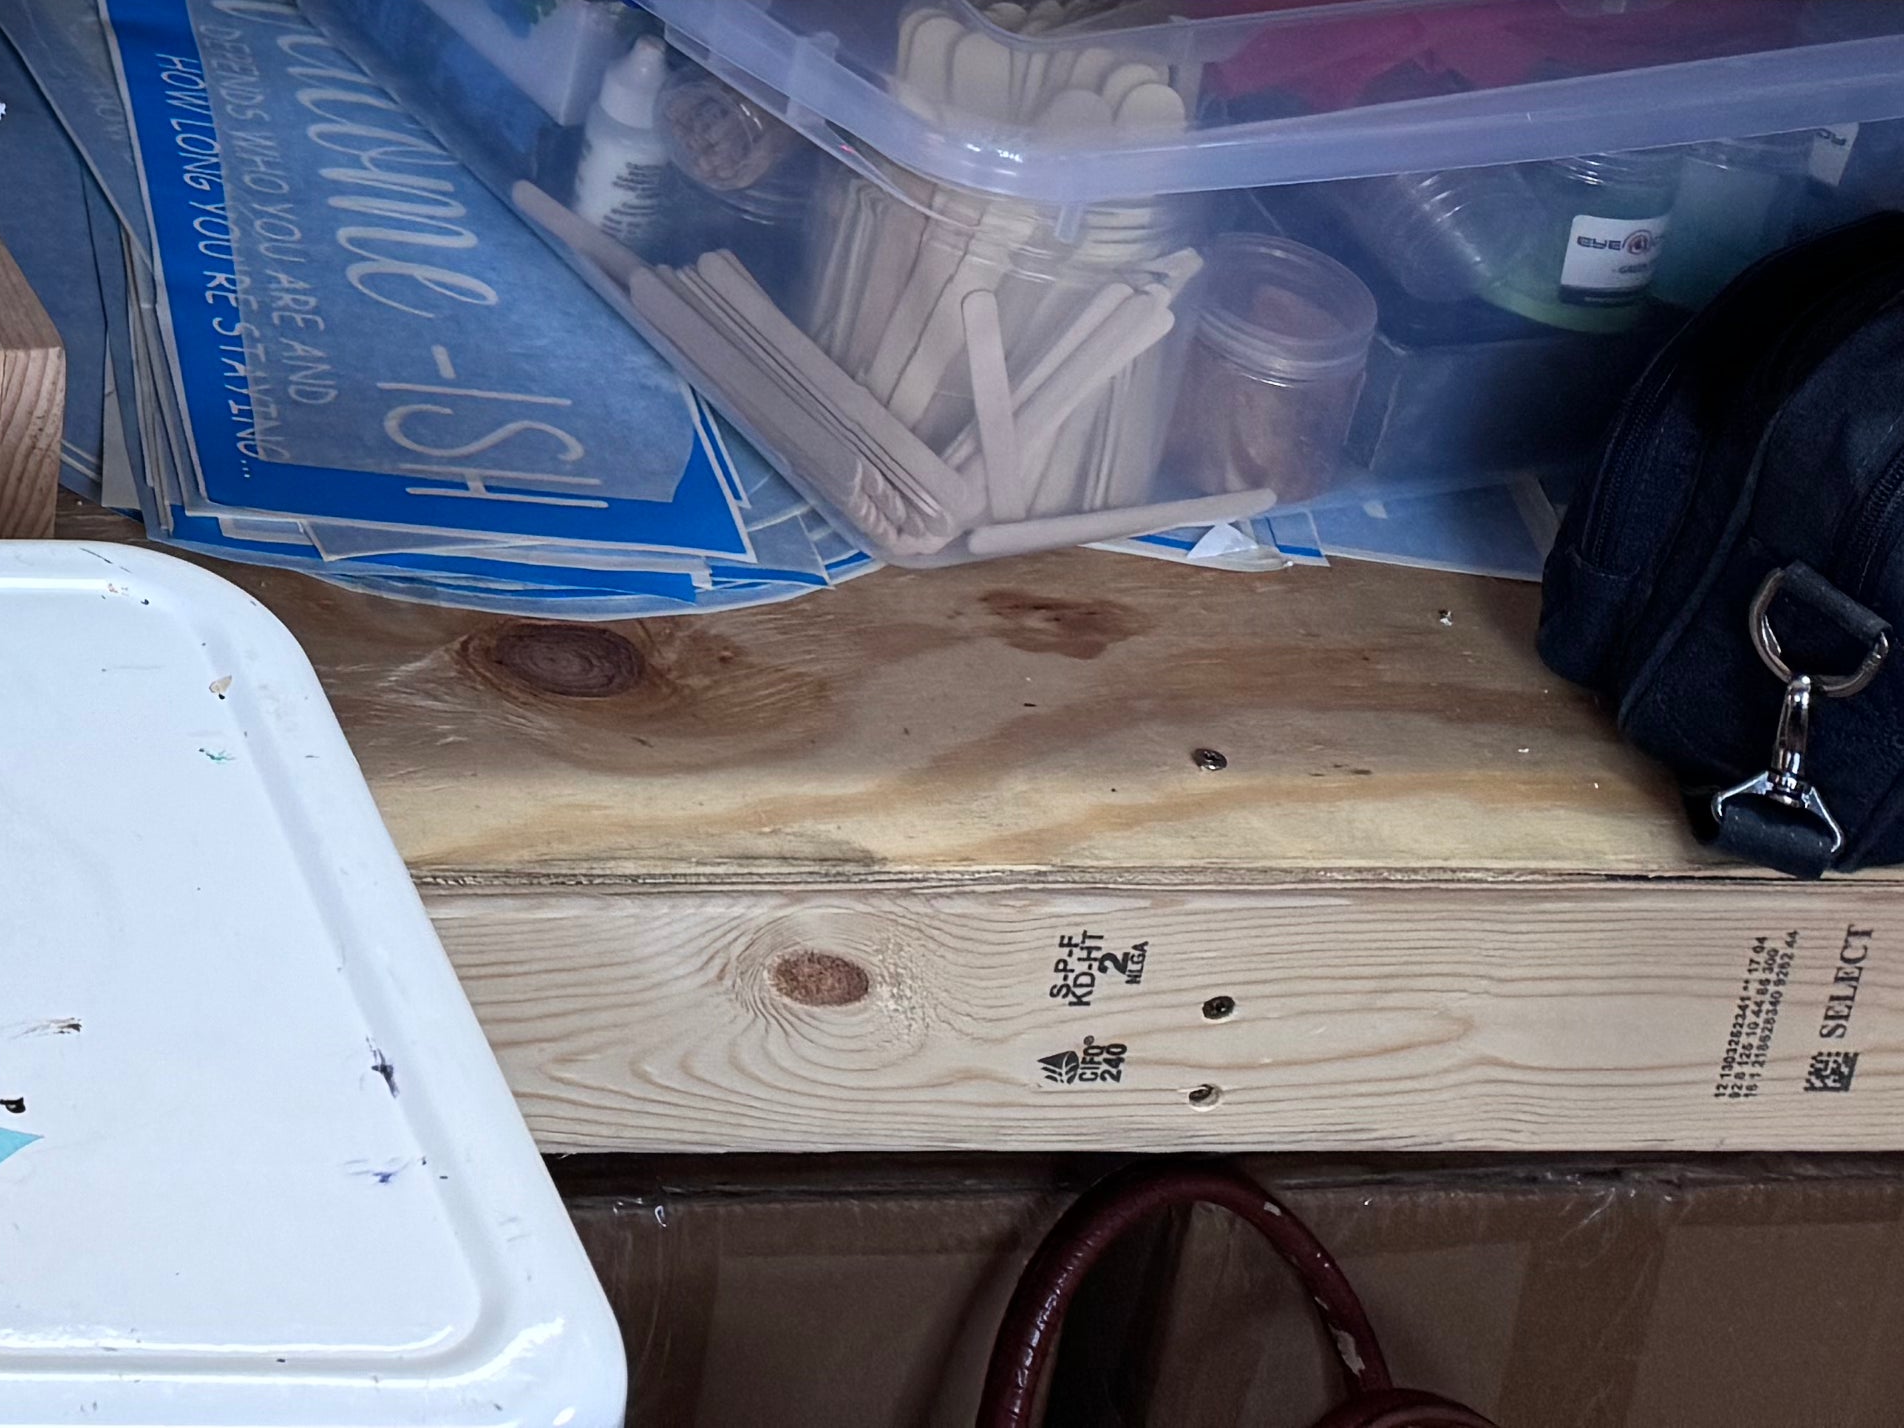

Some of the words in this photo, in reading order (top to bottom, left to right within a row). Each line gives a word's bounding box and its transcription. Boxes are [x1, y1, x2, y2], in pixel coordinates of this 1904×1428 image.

[155, 52, 214, 115] HOW
[200, 23, 270, 122] DEPENDS
[170, 118, 223, 192] LONG
[228, 129, 290, 194] WHO
[252, 202, 306, 263] YOU
[264, 268, 326, 332] ARE
[279, 338, 339, 405] AND
[1049, 935, 1079, 999] S-P-F
[1068, 930, 1104, 1007] KD-HT
[1098, 951, 1130, 975] 2
[1125, 941, 1149, 984] NLGA
[1818, 924, 1874, 1038] SELECT
[1100, 1043, 1127, 1083] 240
